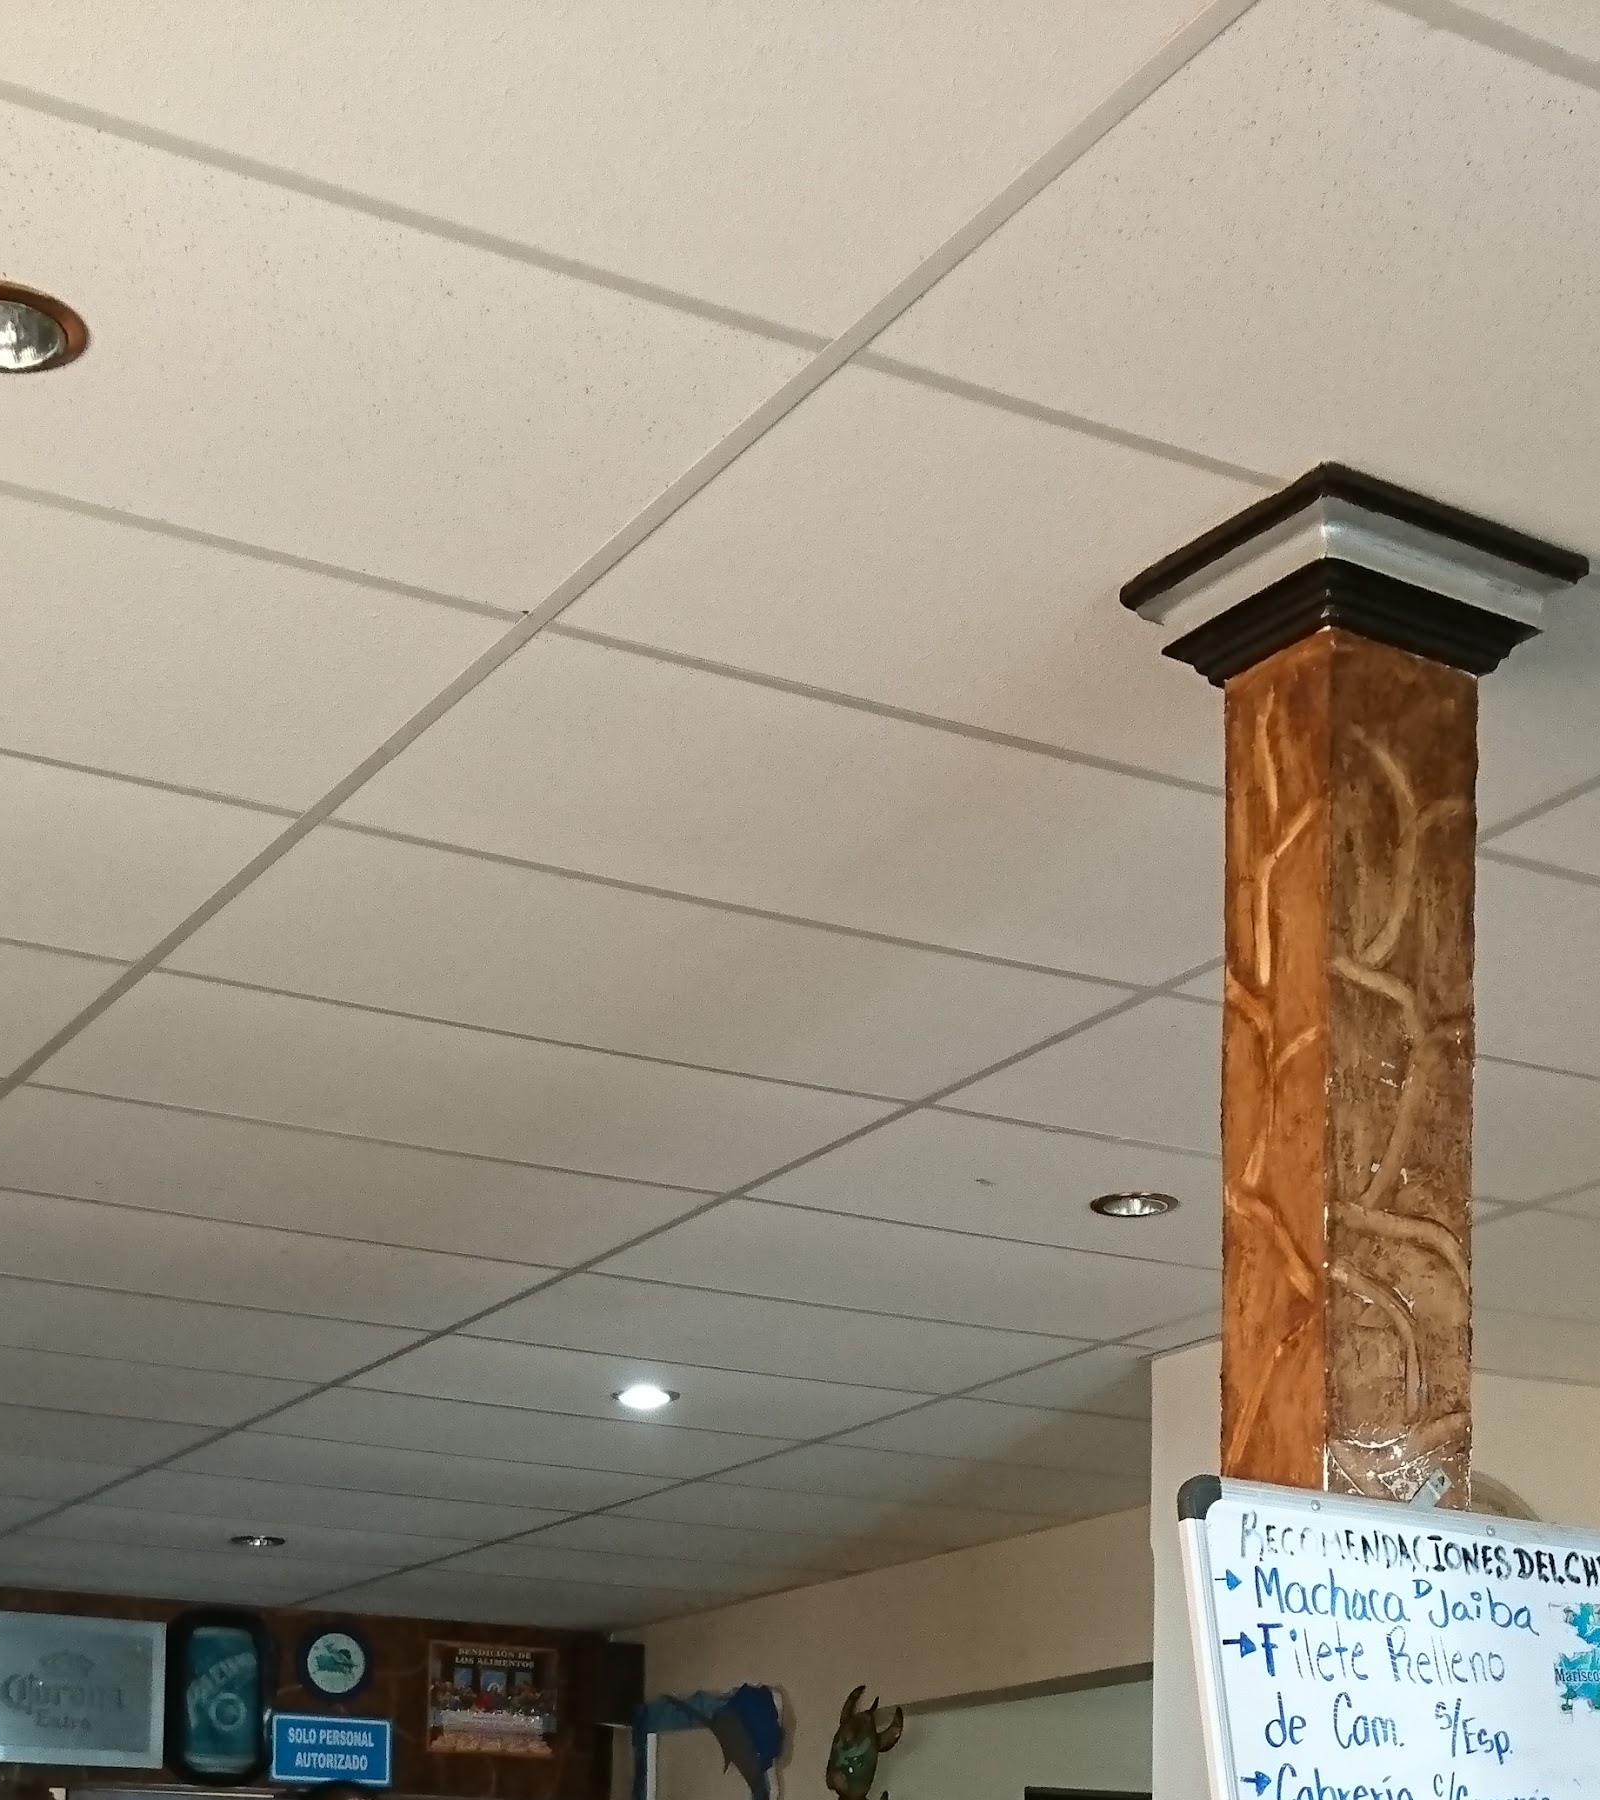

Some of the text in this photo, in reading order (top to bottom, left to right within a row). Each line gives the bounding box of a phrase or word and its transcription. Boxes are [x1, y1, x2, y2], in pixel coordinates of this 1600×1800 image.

[1254, 1565, 1410, 1624] Machaca
[1429, 1588, 1539, 1636] Jaiba
[1257, 1621, 1506, 1685] Filete Relleno
[287, 1727, 375, 1748] SOLO PERSONAL
[1264, 1691, 1307, 1748] de
[295, 1752, 368, 1771] AUTORIZADO
